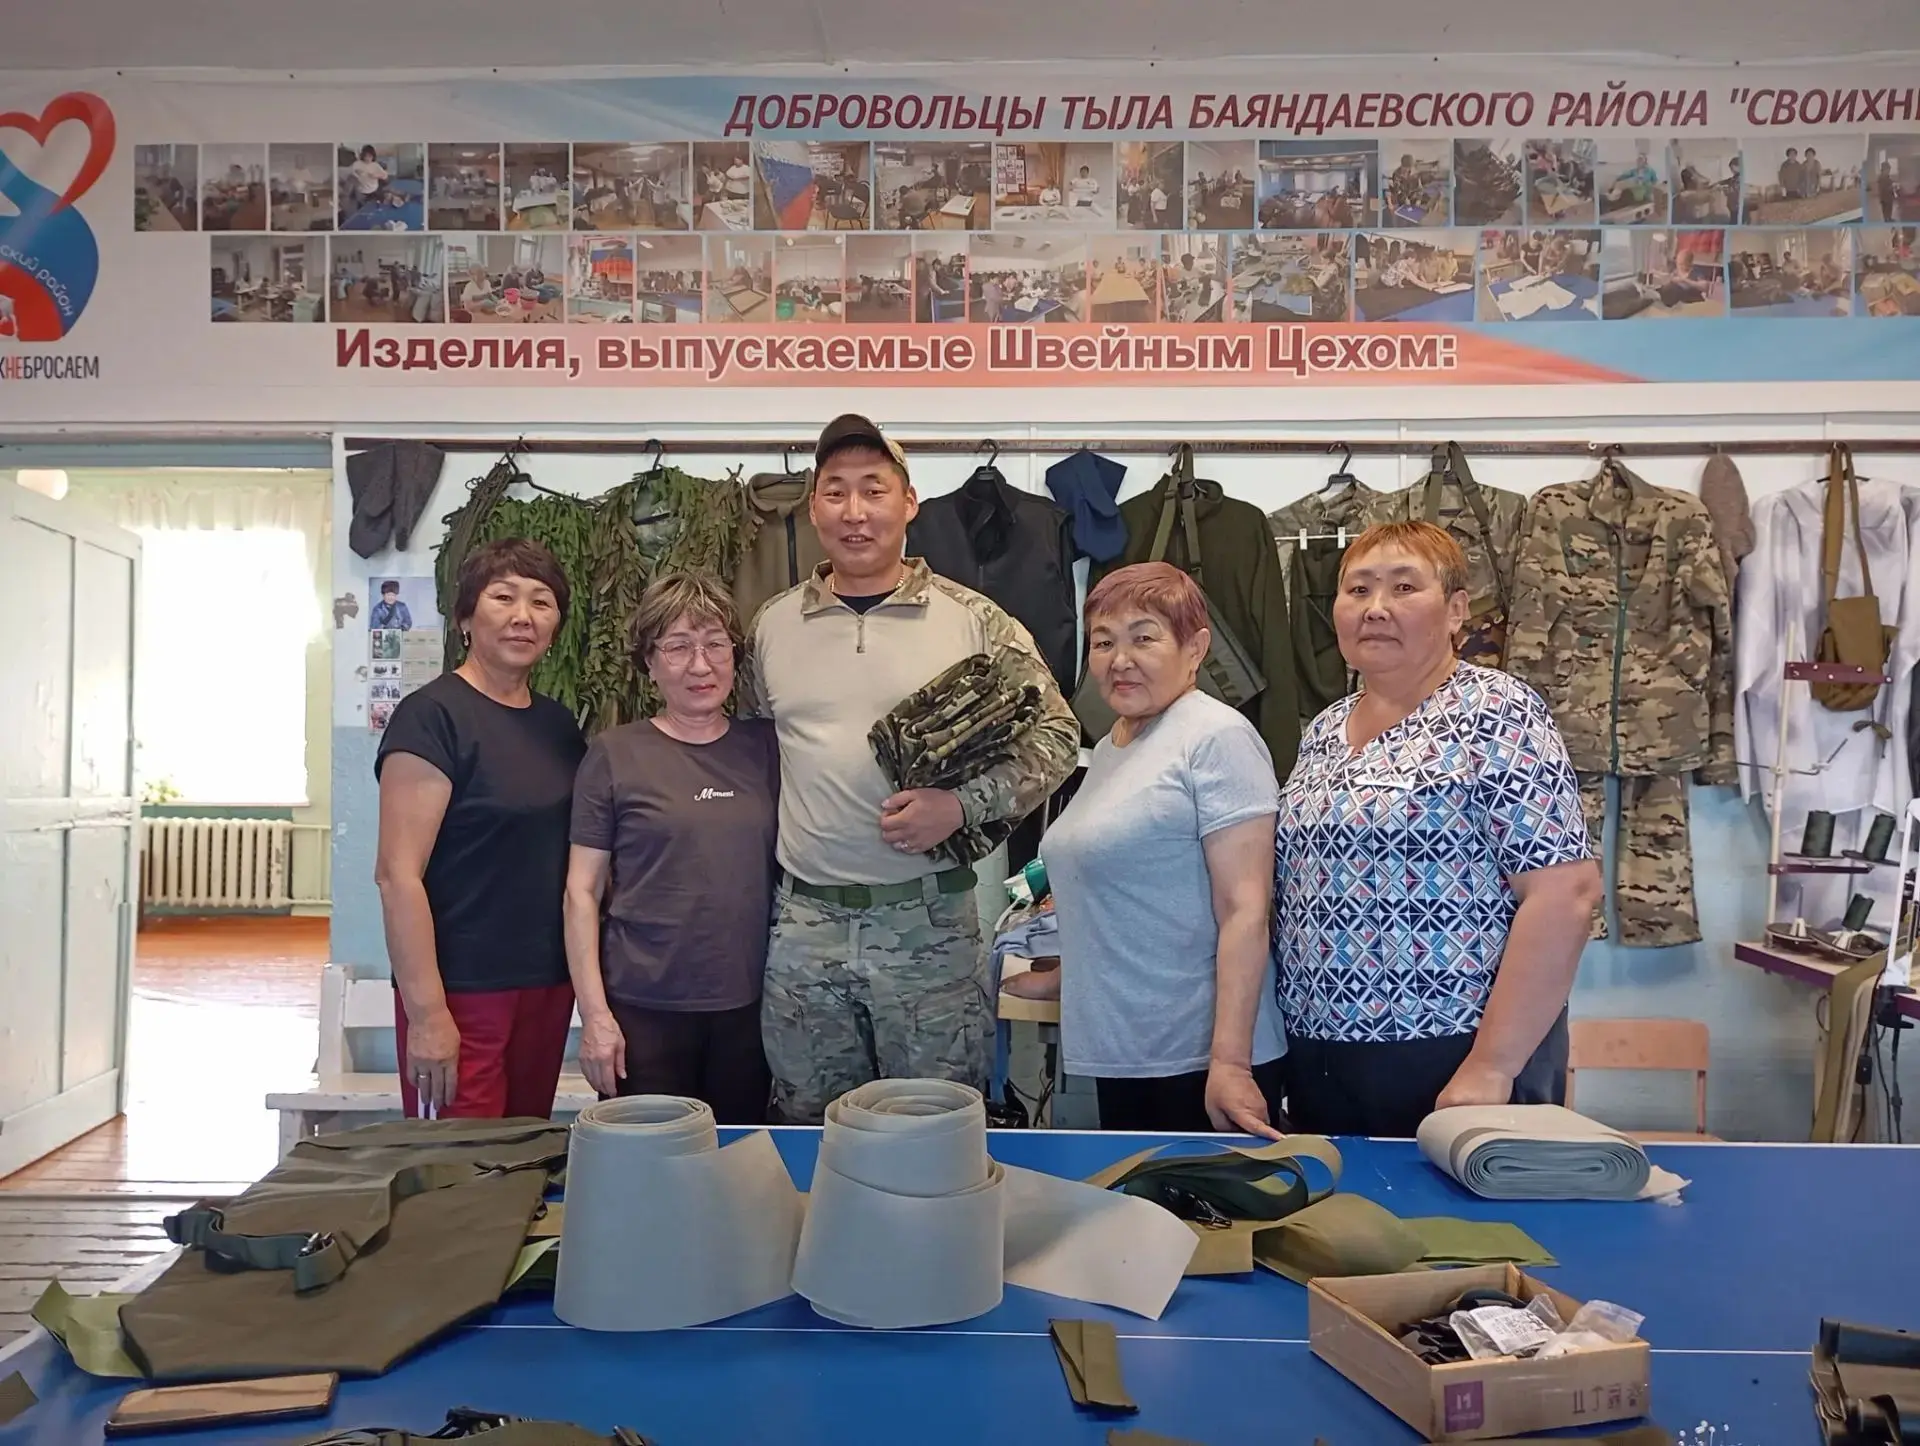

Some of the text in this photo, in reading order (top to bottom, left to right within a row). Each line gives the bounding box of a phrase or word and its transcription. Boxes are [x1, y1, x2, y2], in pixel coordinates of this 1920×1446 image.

[724, 80, 1920, 137] ДОБРОВОЛЬЦЫ ТЫЛА БАЯНДАЕВСКОГО РАЙОНА "СВОИХН
[336, 326, 1459, 380] Изделия, выпускаемые Швейным Цехом:
